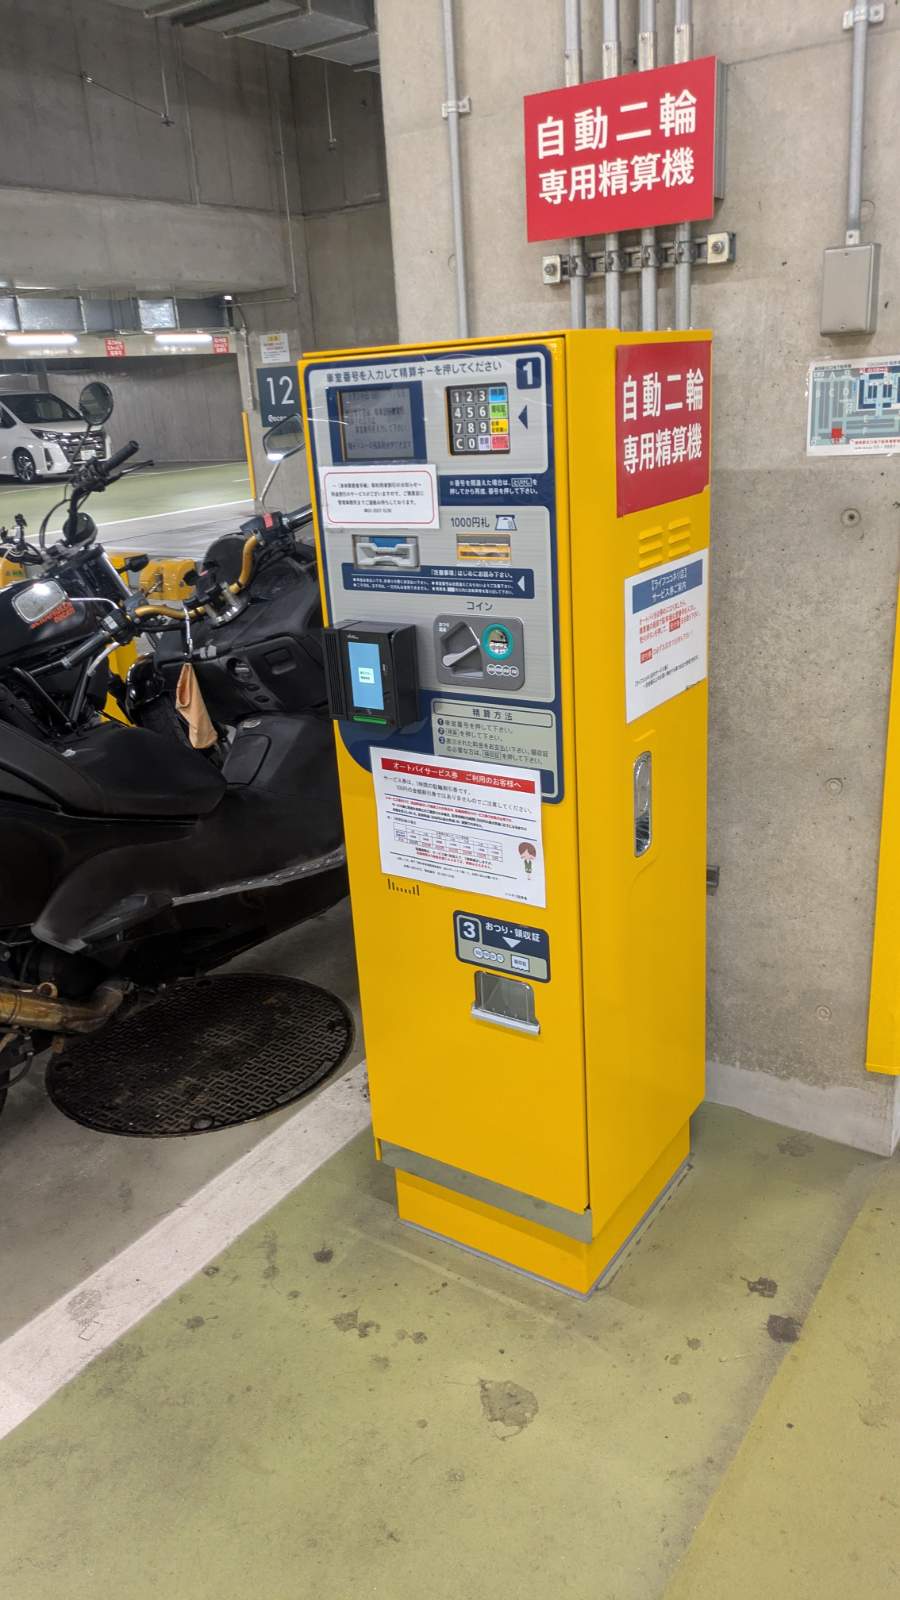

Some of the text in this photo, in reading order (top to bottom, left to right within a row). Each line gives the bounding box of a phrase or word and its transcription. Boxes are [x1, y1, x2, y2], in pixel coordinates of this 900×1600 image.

[537, 89, 697, 159] 自動二輪
[538, 147, 695, 205] 専用精算機
[326, 361, 502, 383] 車室番号を入力して精算キーを押してください
[523, 361, 533, 385] 1
[266, 375, 295, 405] 12
[454, 392, 460, 402] 1
[466, 391, 473, 402] 2
[479, 391, 486, 402] 3
[623, 368, 704, 422] 自動二輪
[454, 406, 486, 418] 4 5 6
[456, 423, 462, 434] 7
[468, 423, 474, 433] 8
[480, 422, 487, 432] 9
[456, 439, 463, 449] C
[468, 439, 475, 449] 0
[623, 423, 702, 474] 専用精算機
[450, 517, 490, 528] 1000円札
[466, 601, 493, 611] コイン
[393, 761, 522, 789] オートバイサービス券 ご利用のお客様へ
[463, 921, 476, 938] 3
[485, 922, 541, 943] おつり・領収証
